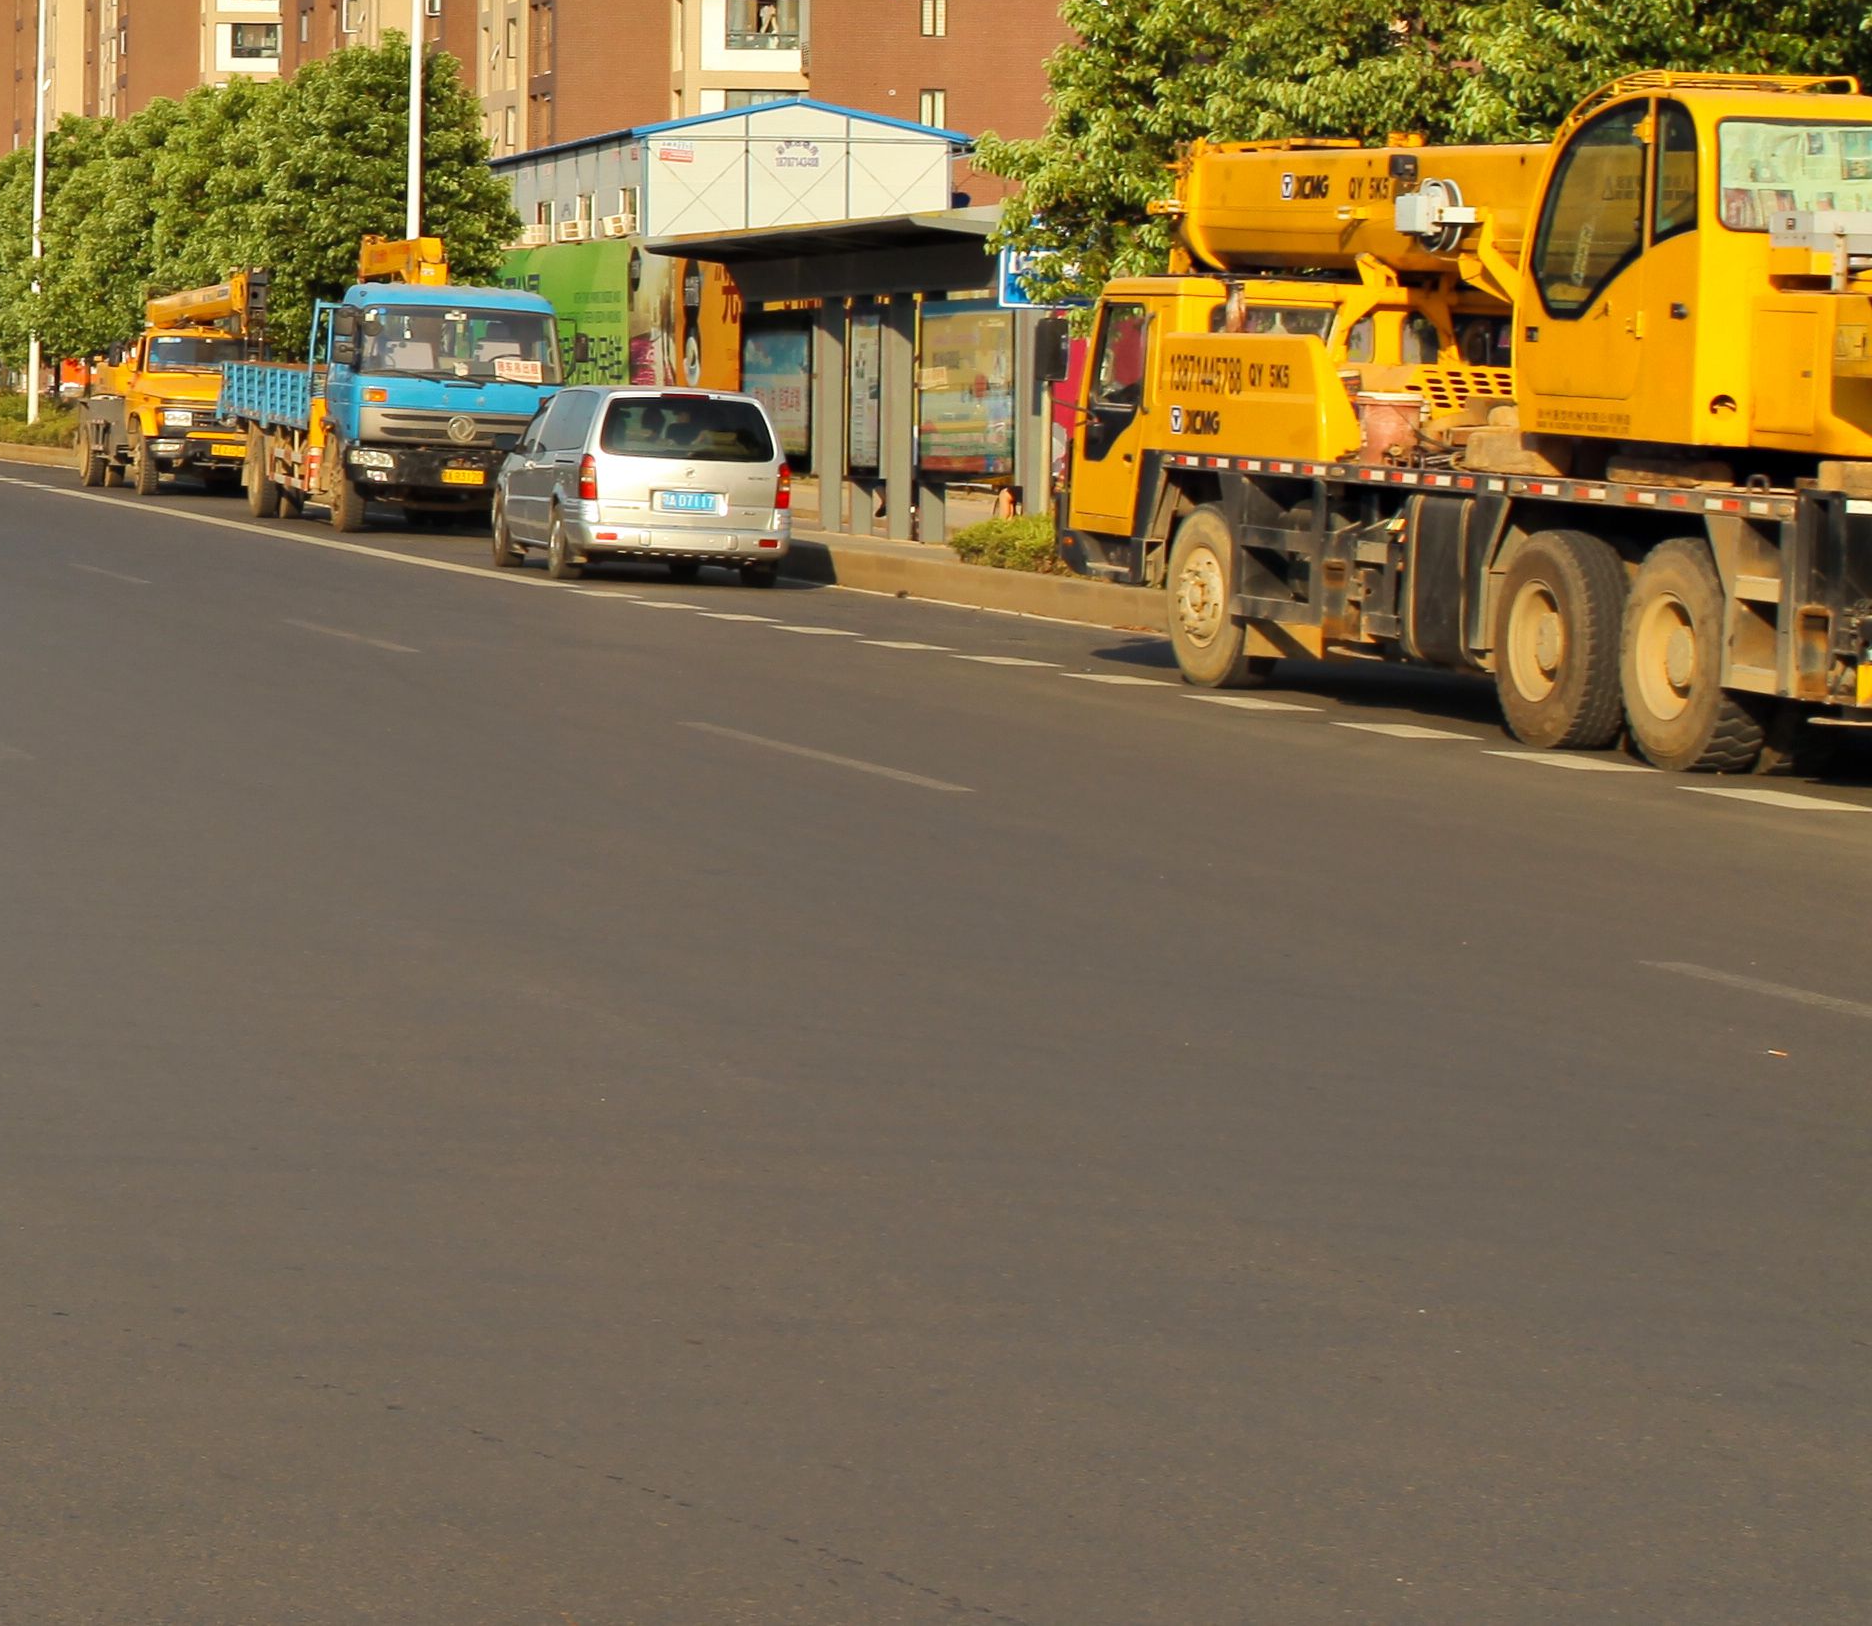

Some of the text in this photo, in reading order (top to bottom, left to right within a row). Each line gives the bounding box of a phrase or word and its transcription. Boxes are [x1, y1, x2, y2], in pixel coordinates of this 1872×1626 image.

[1293, 175, 1329, 199] XCMG
[1348, 177, 1364, 199] QY
[1248, 363, 1264, 387] QY
[1183, 410, 1221, 435] XCMG
